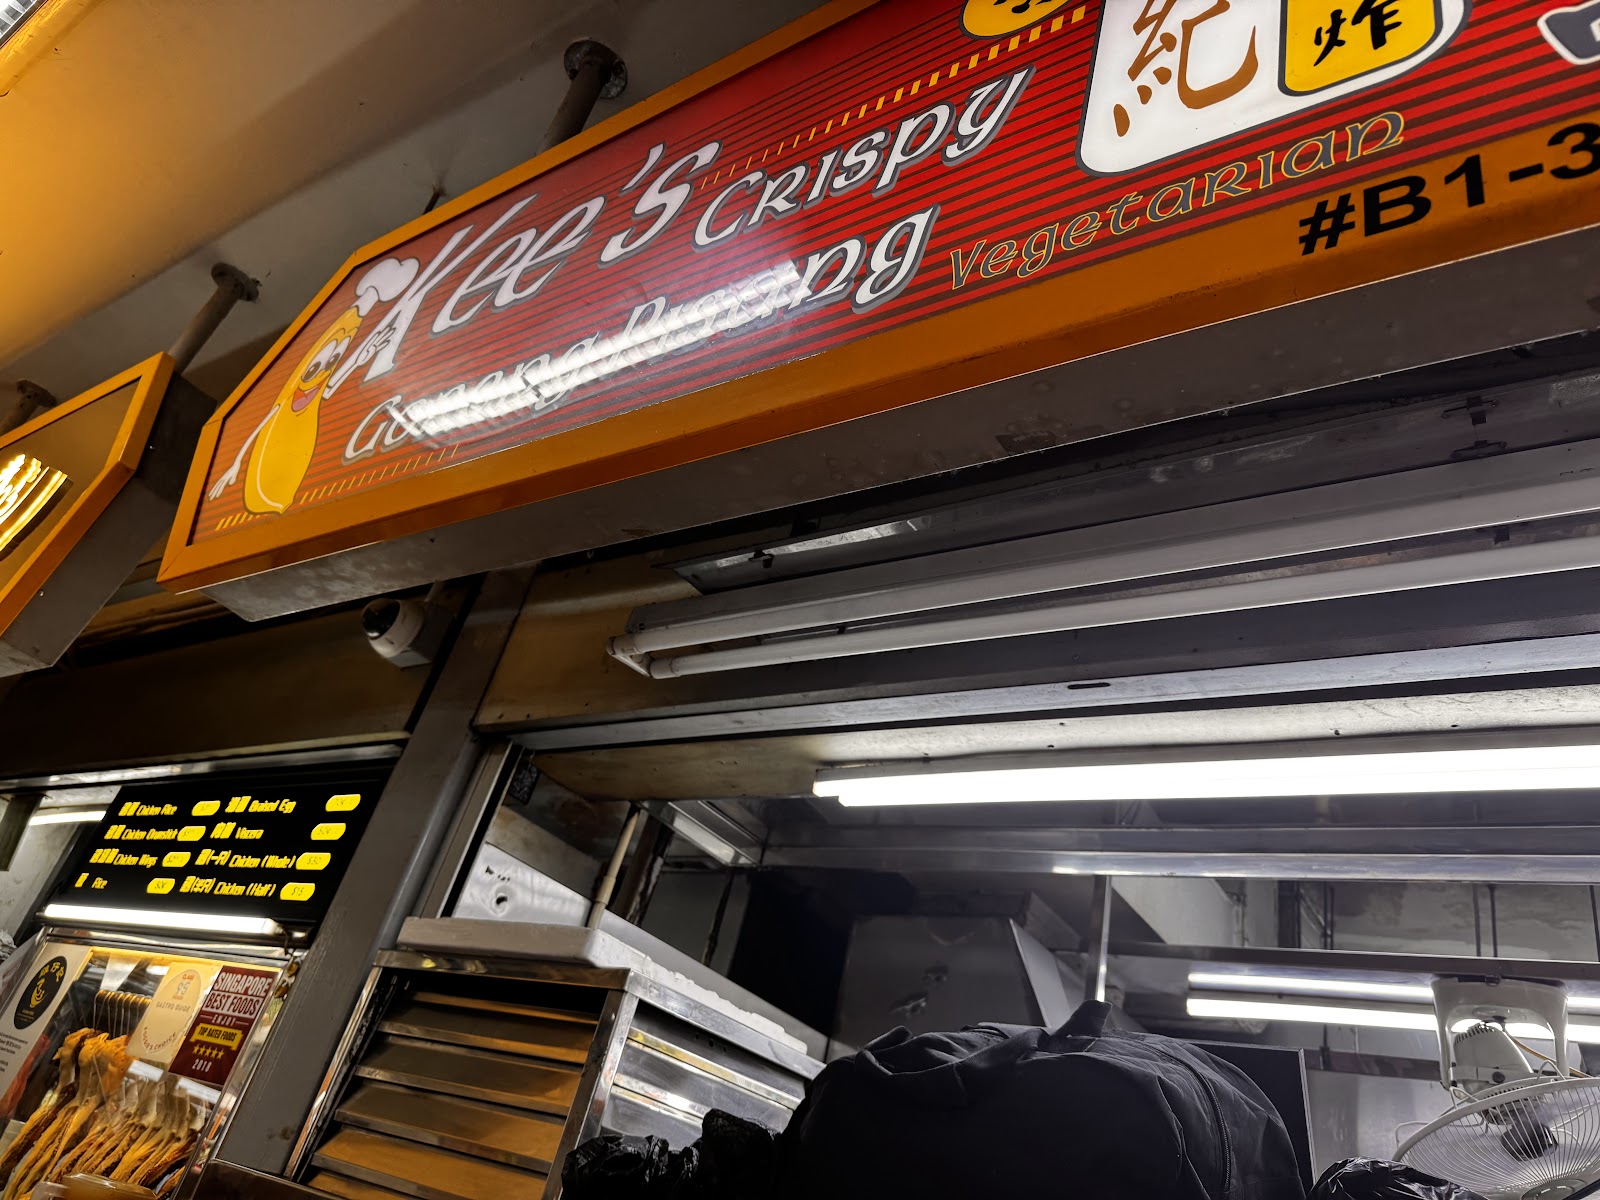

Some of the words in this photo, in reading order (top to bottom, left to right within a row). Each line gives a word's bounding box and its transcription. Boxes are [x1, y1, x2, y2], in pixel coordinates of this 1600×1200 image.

[1313, 0, 1403, 67] 炸
[278, 799, 297, 814] Egg
[228, 854, 261, 868] Chicken
[213, 882, 246, 895] Chicken
[213, 972, 273, 997] SINGAPORE
[205, 991, 232, 1012] BEST
[227, 994, 260, 1016] FOODS
[211, 1014, 237, 1026] ENJOY
[198, 1026, 209, 1036] TOP
[205, 1027, 223, 1039] RATED
[219, 1030, 238, 1041] FOODS
[191, 1058, 213, 1073] 2018
